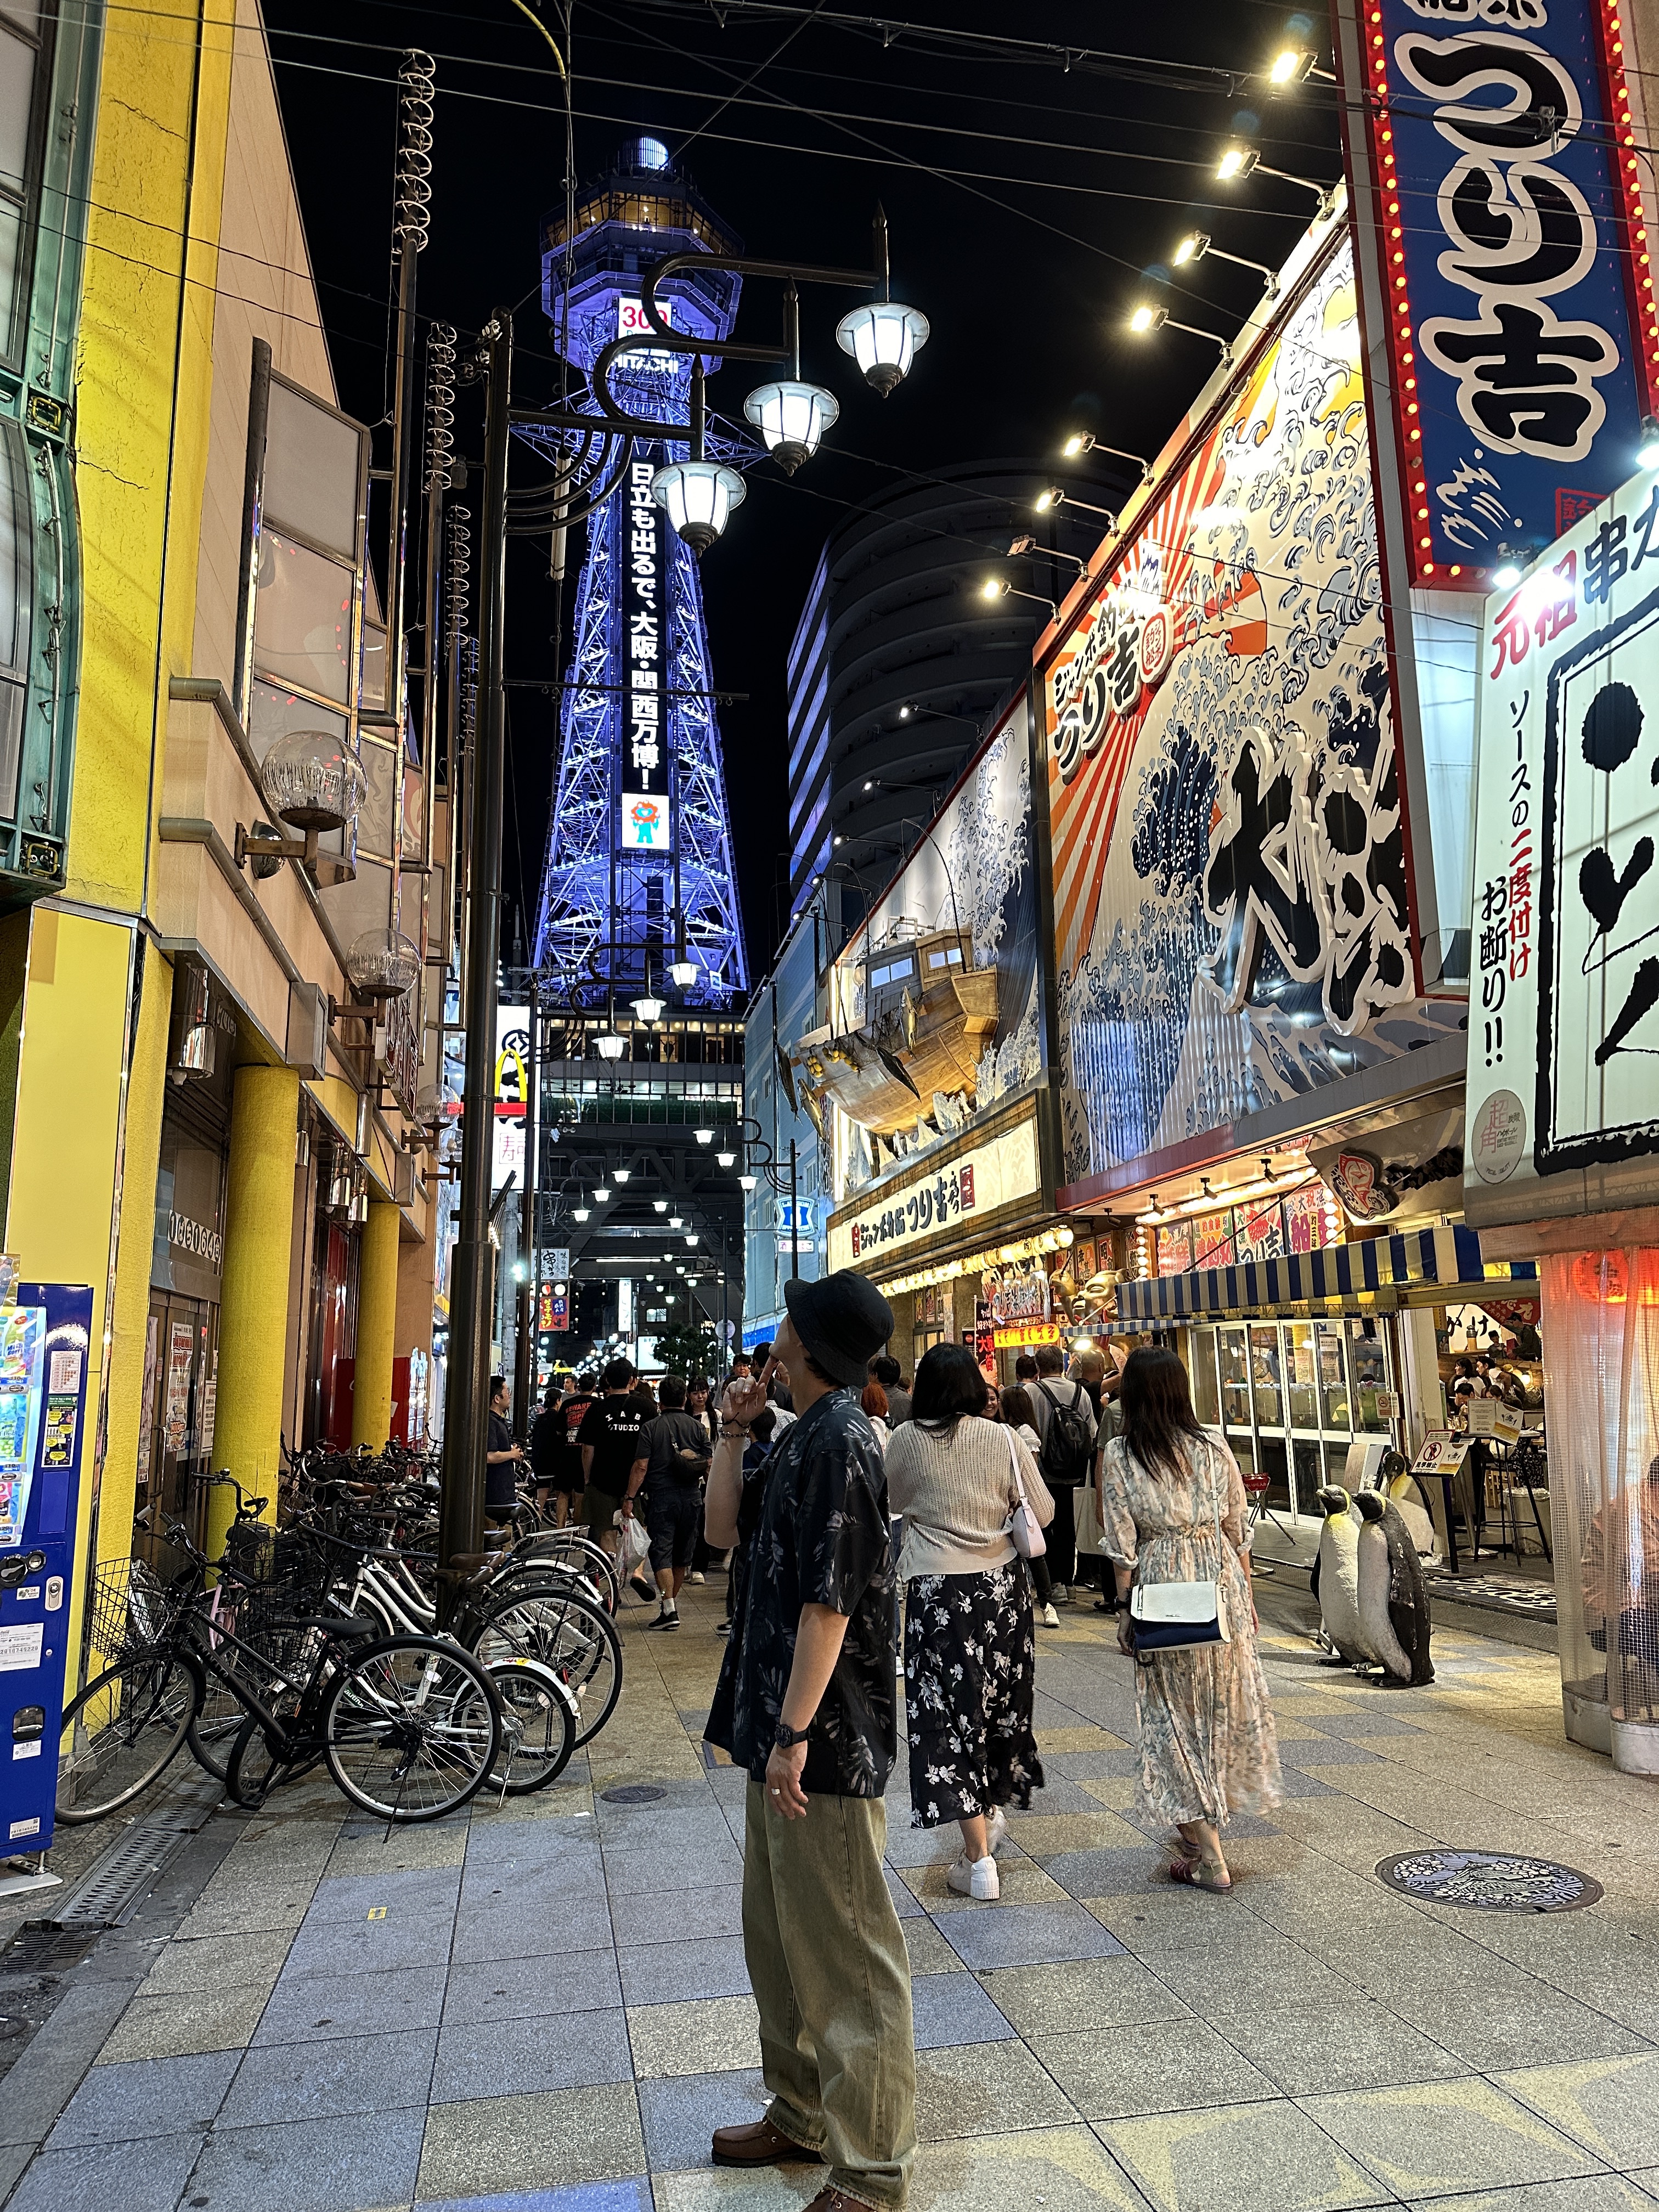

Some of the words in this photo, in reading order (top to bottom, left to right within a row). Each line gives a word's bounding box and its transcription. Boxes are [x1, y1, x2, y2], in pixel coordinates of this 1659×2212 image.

[1509, 690, 1533, 981] ソースの二度付け
